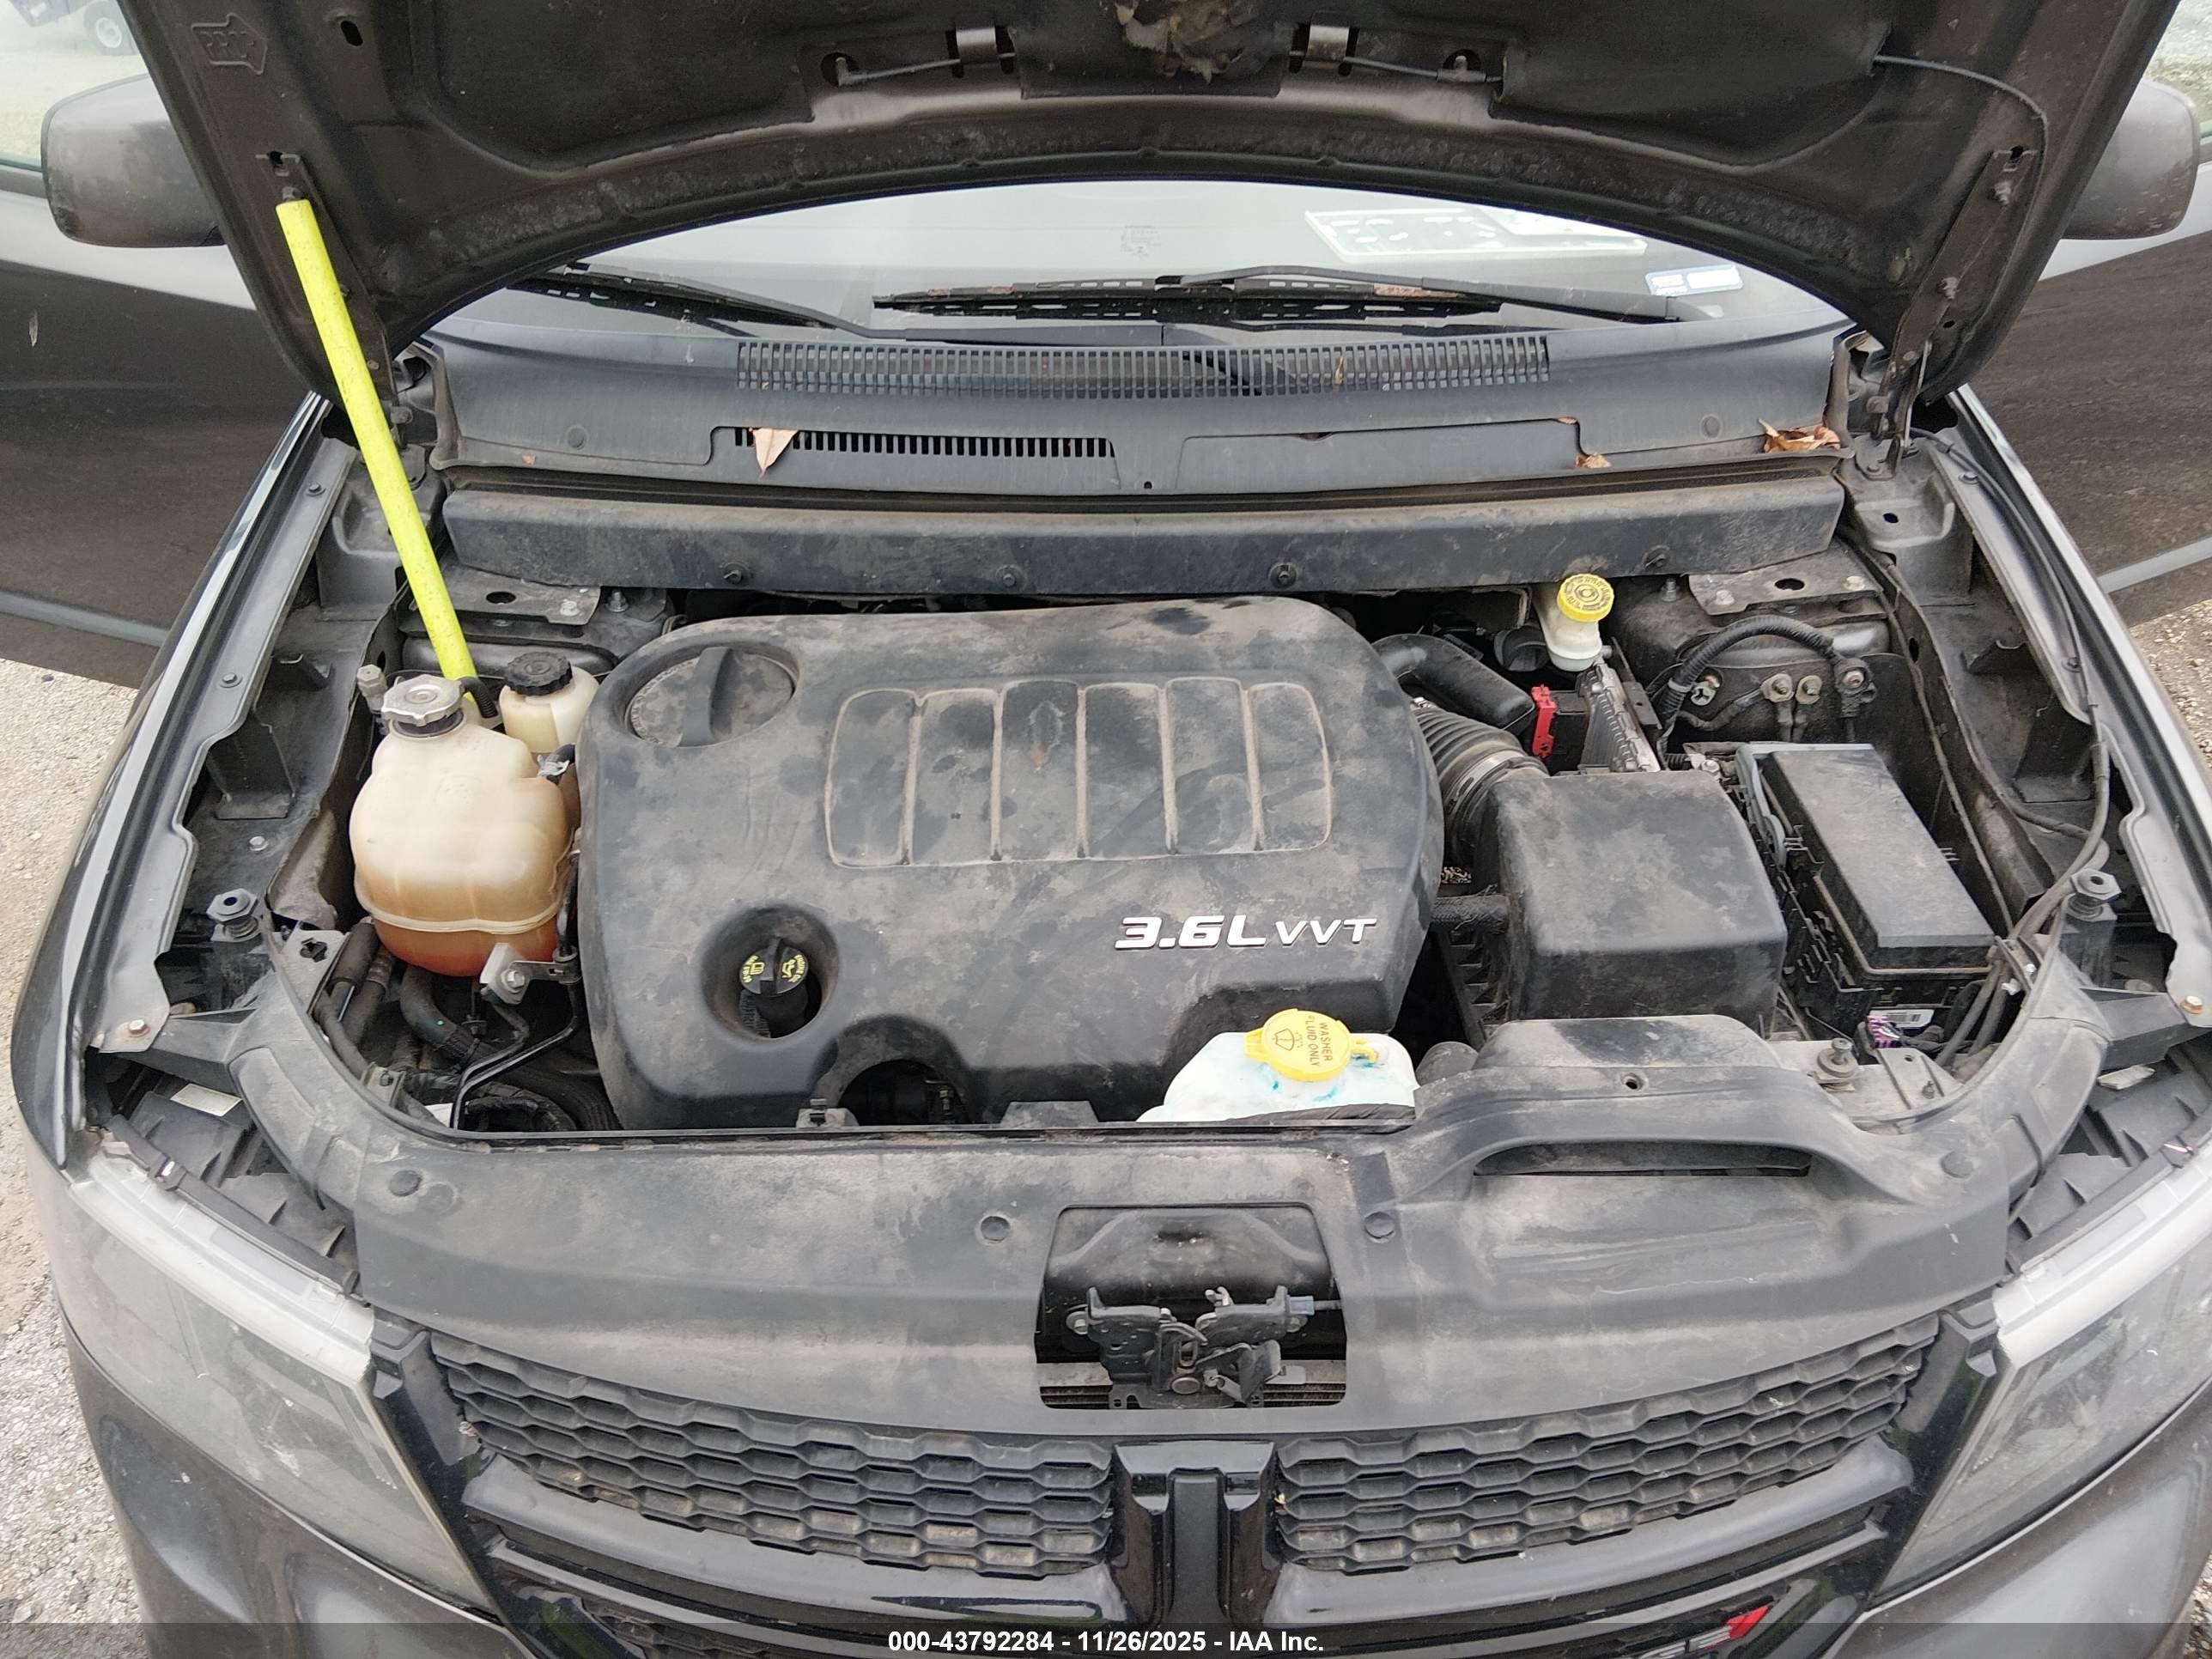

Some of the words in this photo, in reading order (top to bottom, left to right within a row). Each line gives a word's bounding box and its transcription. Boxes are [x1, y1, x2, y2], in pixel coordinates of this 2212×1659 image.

[1115, 915, 1267, 950] 3.6L
[1274, 918, 1377, 946] VVT
[1305, 1015, 1317, 1041] FLUID
[1319, 1022, 1334, 1061] WASHER
[1310, 1042, 1321, 1066] ONLY
